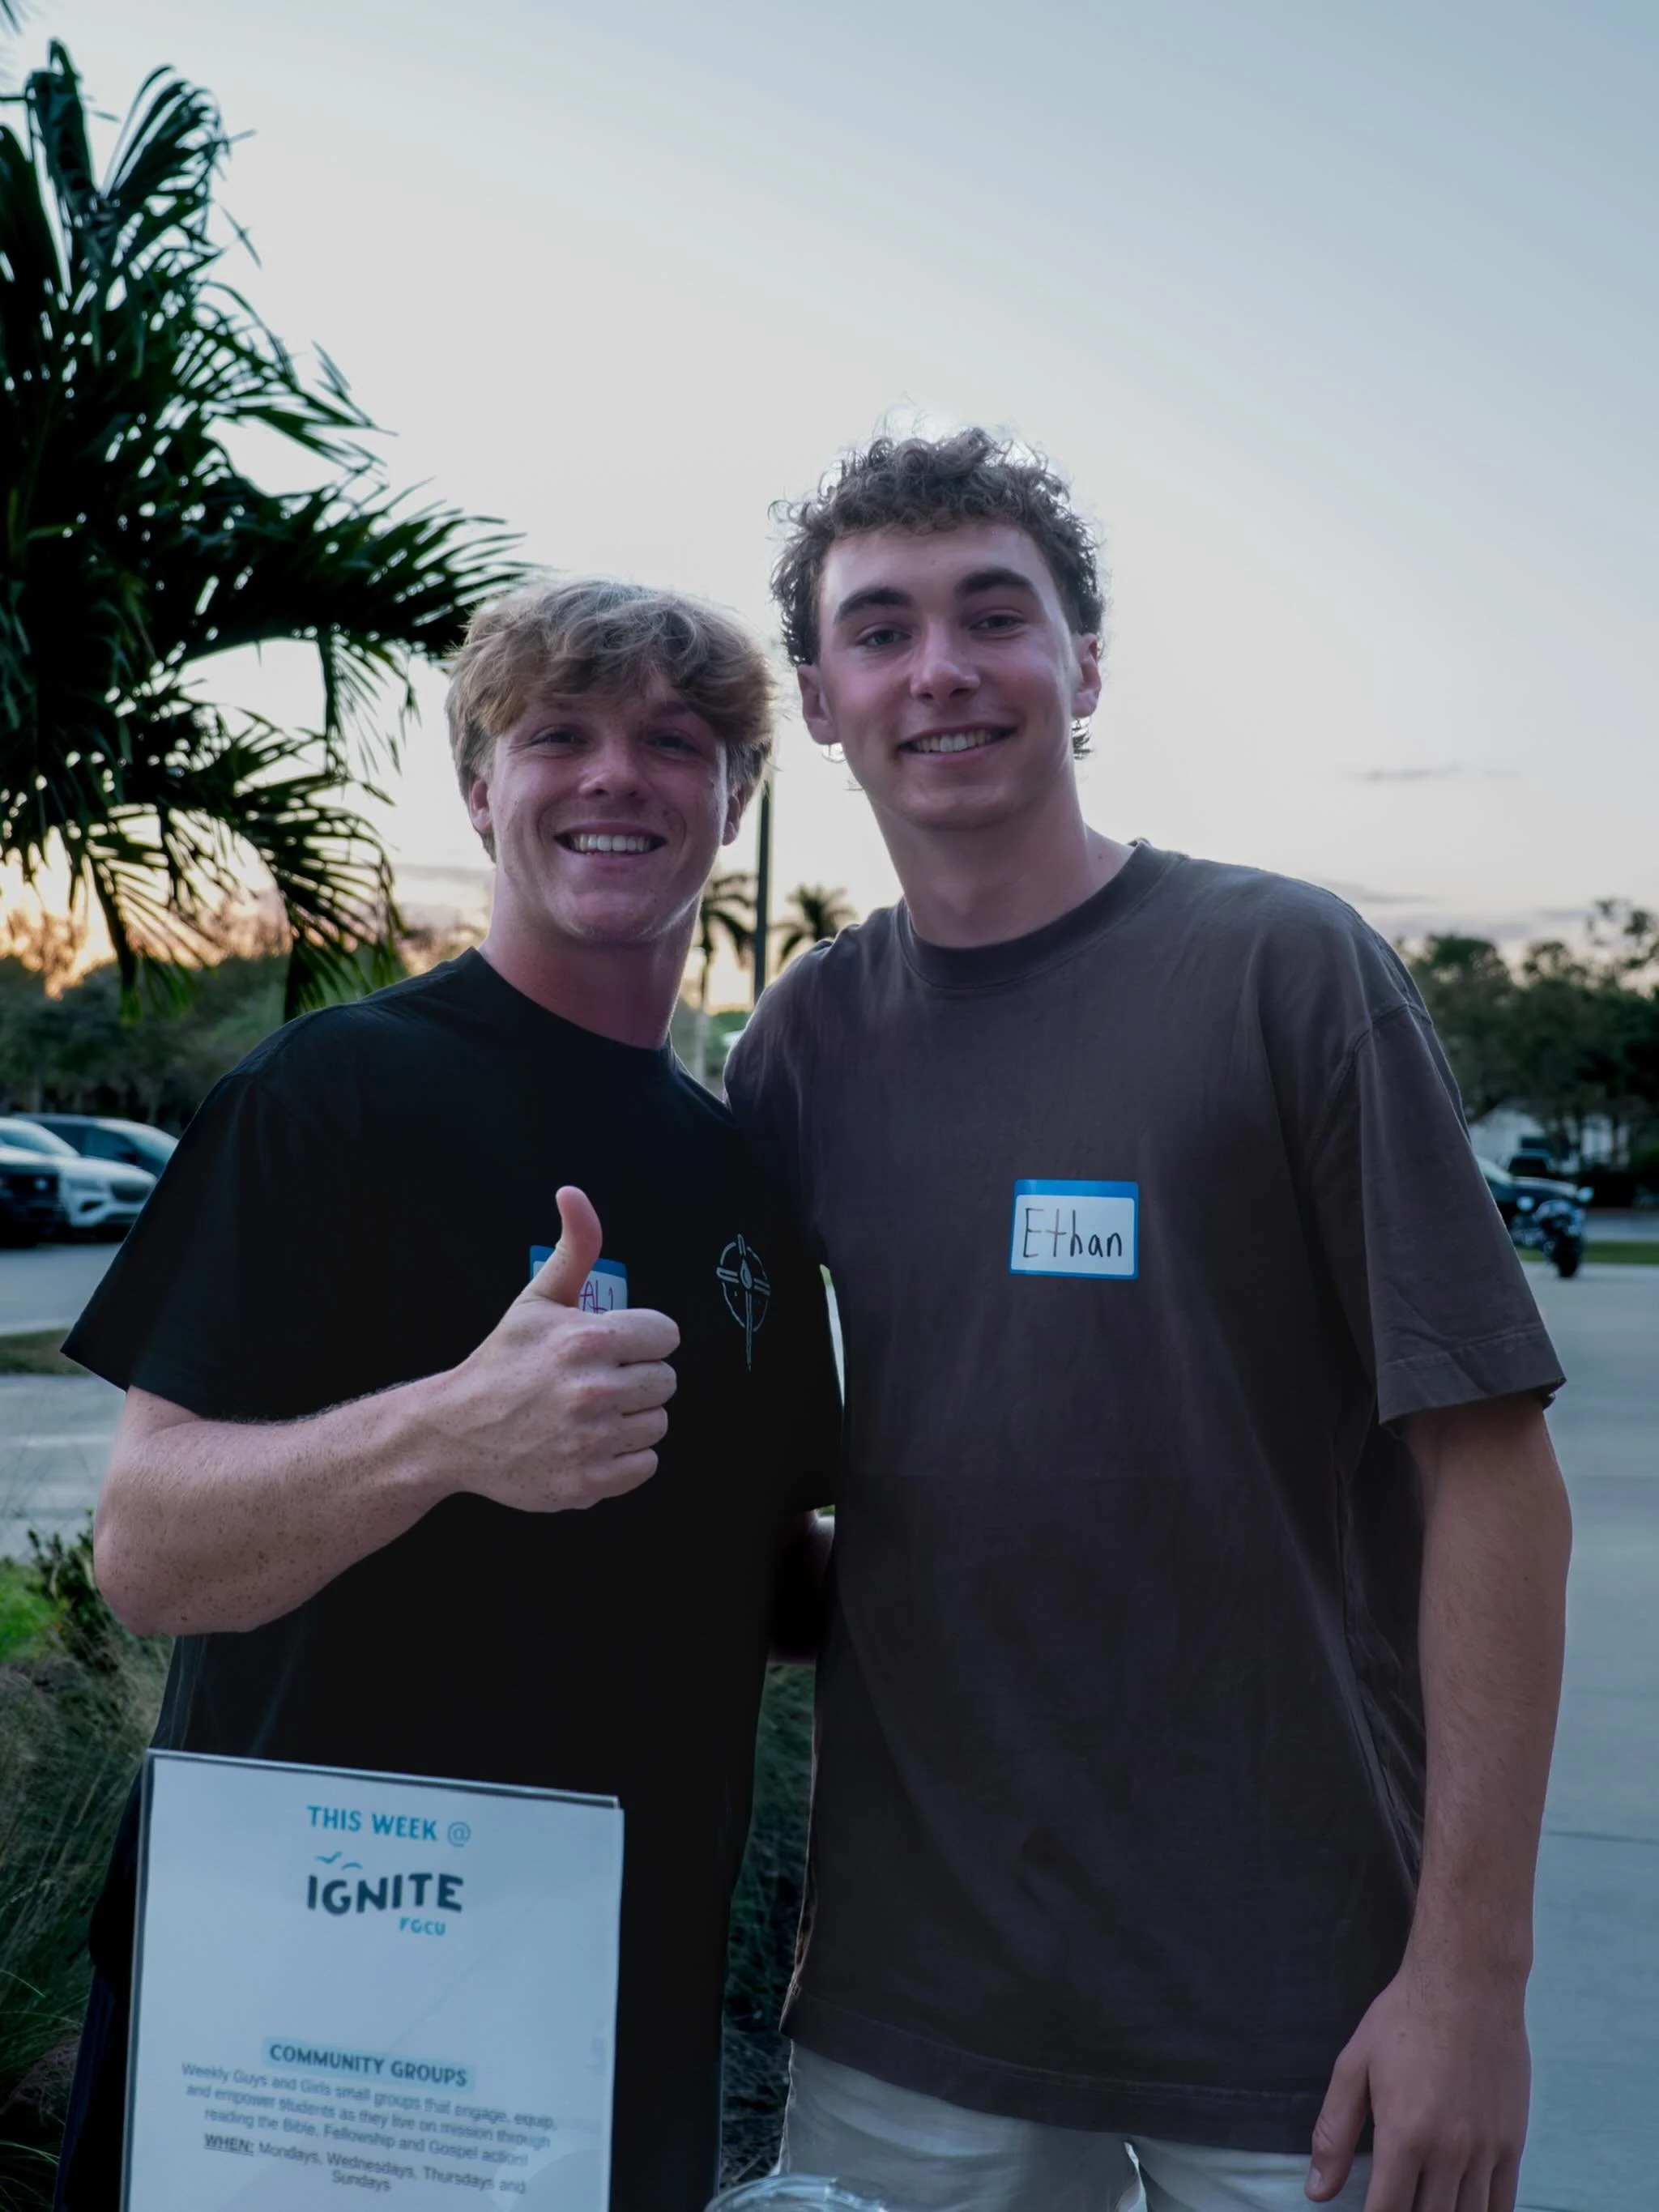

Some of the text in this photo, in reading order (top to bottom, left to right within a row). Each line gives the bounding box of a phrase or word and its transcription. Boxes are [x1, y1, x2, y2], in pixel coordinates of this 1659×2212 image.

[1023, 1208, 1122, 1257] Ethan
[307, 1805, 471, 1848] THIS WEEK @
[307, 1873, 464, 1916] IGNITE
[399, 1917, 446, 1936] FGCU
[181, 2062, 229, 2084] Weekly
[232, 2069, 268, 2088] Guys
[271, 2077, 297, 2091] and
[301, 2078, 331, 2096] Girls
[335, 2086, 371, 2102] small
[374, 2093, 421, 2111] groups
[424, 2097, 451, 2115] that
[270, 2043, 467, 2088] COMMUNITY GROUPS
[186, 2084, 551, 2151] and empower students as they live on mission through
[205, 2108, 254, 2129] reading
[258, 2115, 279, 2130] the
[324, 2123, 395, 2149] Fellowship
[399, 2137, 425, 2153] and
[429, 2139, 479, 2160] Gospel
[204, 2133, 254, 2157] WHEN:
[258, 2141, 322, 2166] Mondays,
[424, 2166, 494, 2192] Thursdays
[331, 2168, 391, 2192] Sundays
